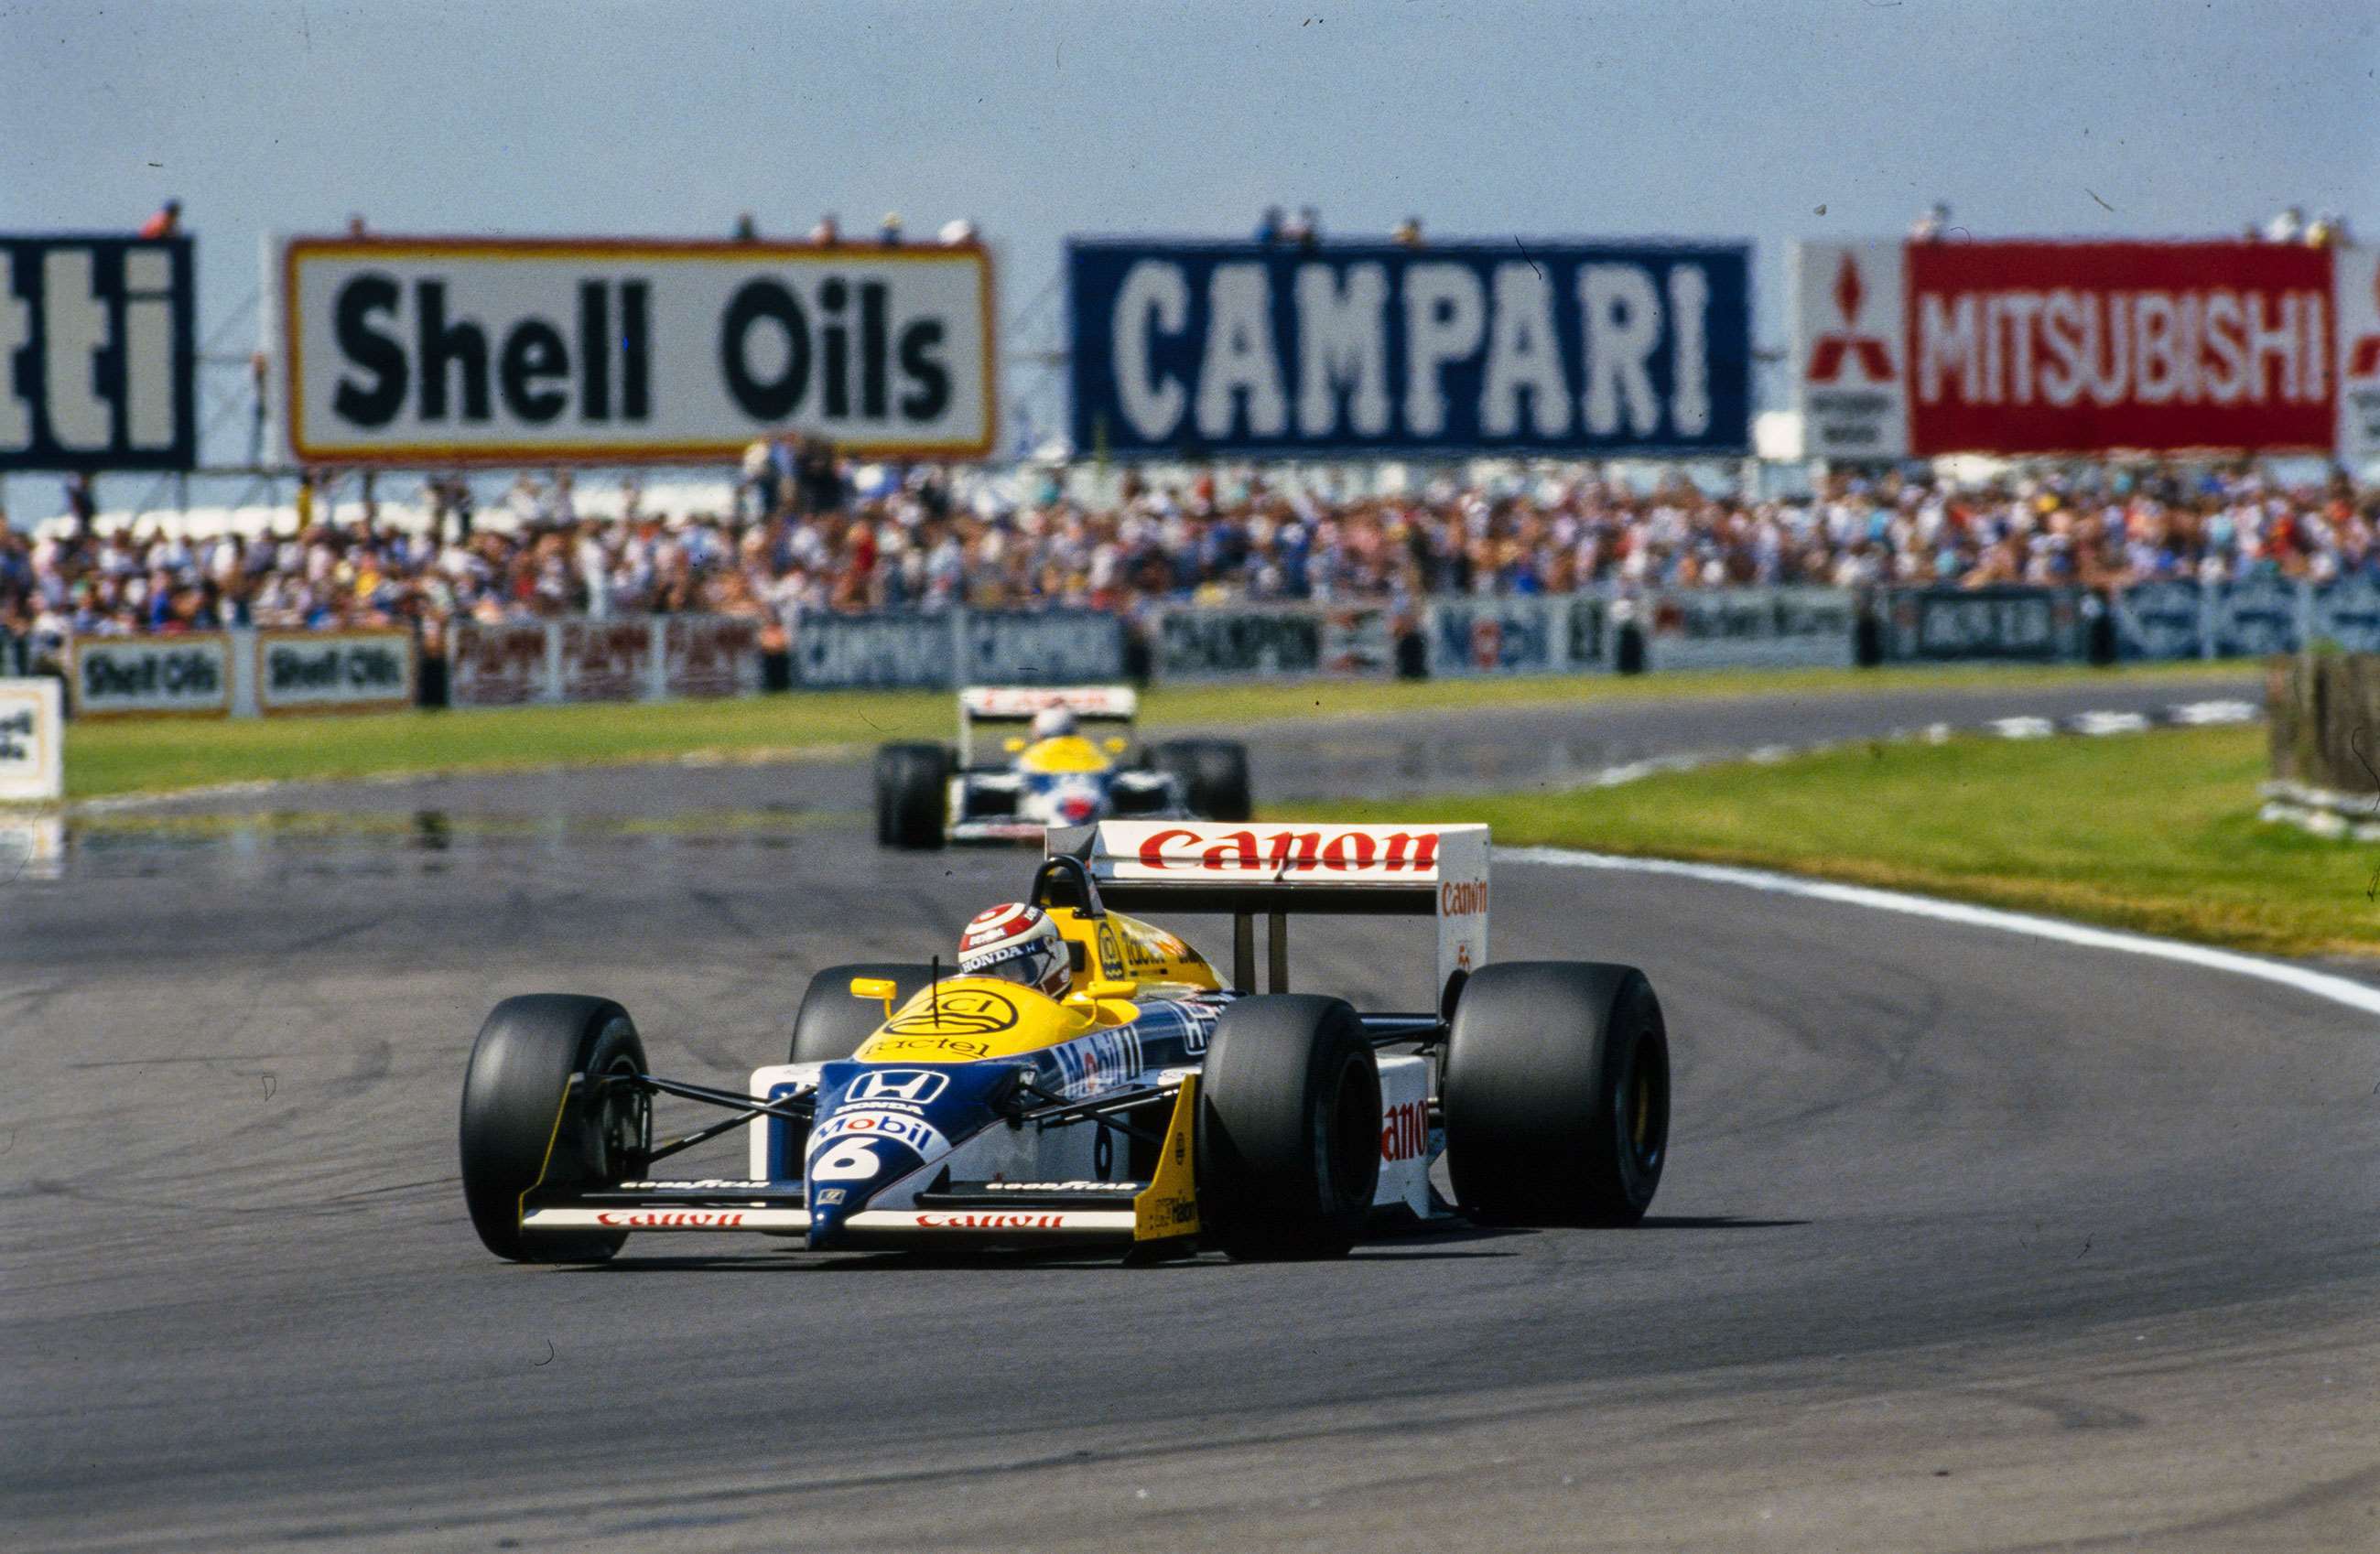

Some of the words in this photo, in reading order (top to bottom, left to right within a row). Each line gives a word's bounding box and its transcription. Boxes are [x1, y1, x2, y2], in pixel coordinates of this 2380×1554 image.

[333, 275, 648, 431] Shell
[719, 274, 952, 426] Oils
[1111, 259, 1710, 441] CAMPARI
[1918, 289, 2327, 406] MITSUBISHI
[1139, 829, 1440, 872] Canon
[958, 946, 1023, 974] HONDA
[818, 1116, 933, 1151] Mobil
[1381, 1099, 1427, 1162] ano
[811, 1137, 880, 1181] 6
[915, 1213, 1064, 1228] Canon
